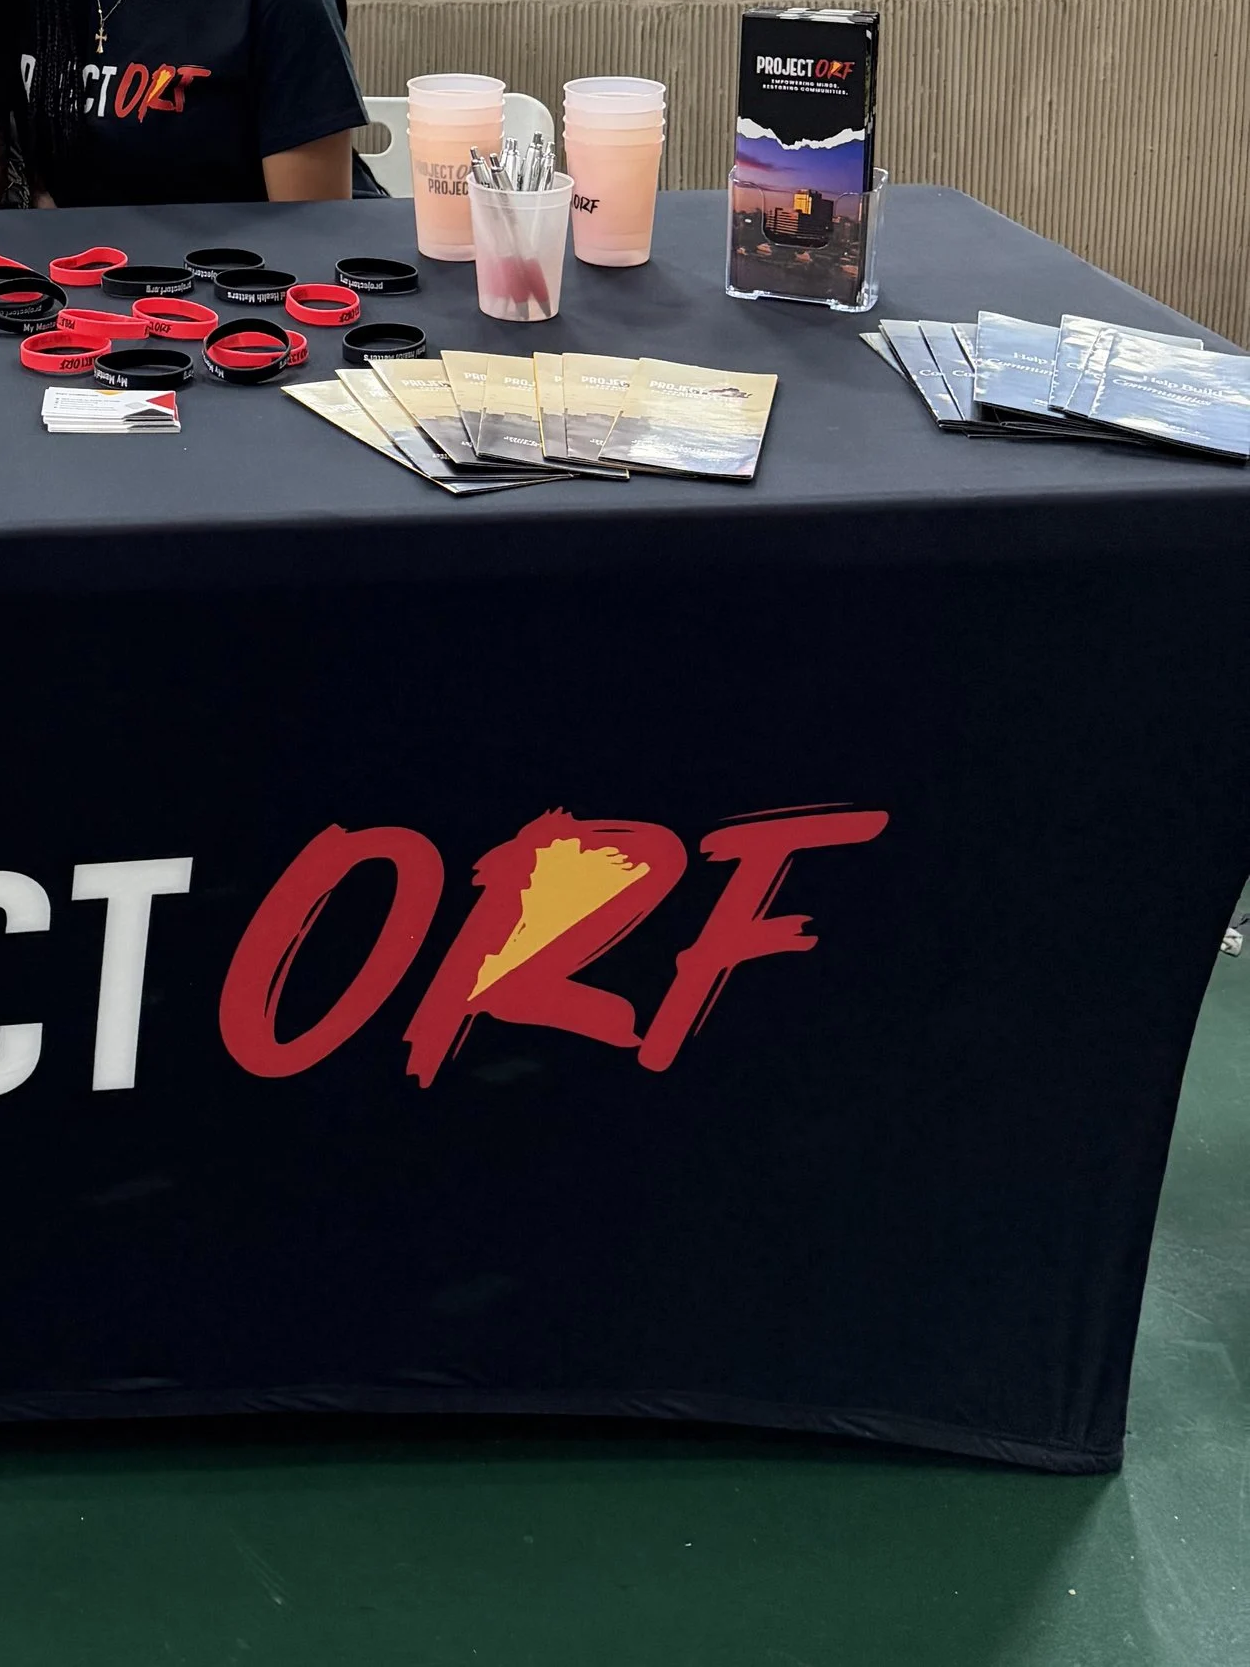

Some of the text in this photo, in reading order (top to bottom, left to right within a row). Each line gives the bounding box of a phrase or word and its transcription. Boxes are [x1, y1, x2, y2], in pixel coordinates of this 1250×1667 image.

[756, 55, 856, 81] PROJECT ORF
[762, 83, 849, 96] RESTORING COMMUNITIES.
[771, 78, 815, 86] EMPOWERING
[573, 193, 600, 215] ORF
[227, 291, 256, 304] Matters
[23, 322, 34, 334] My
[116, 376, 128, 388] My
[1142, 375, 1224, 398] Help Build
[1112, 378, 1212, 407] Communities
[218, 808, 890, 1091] ORF
